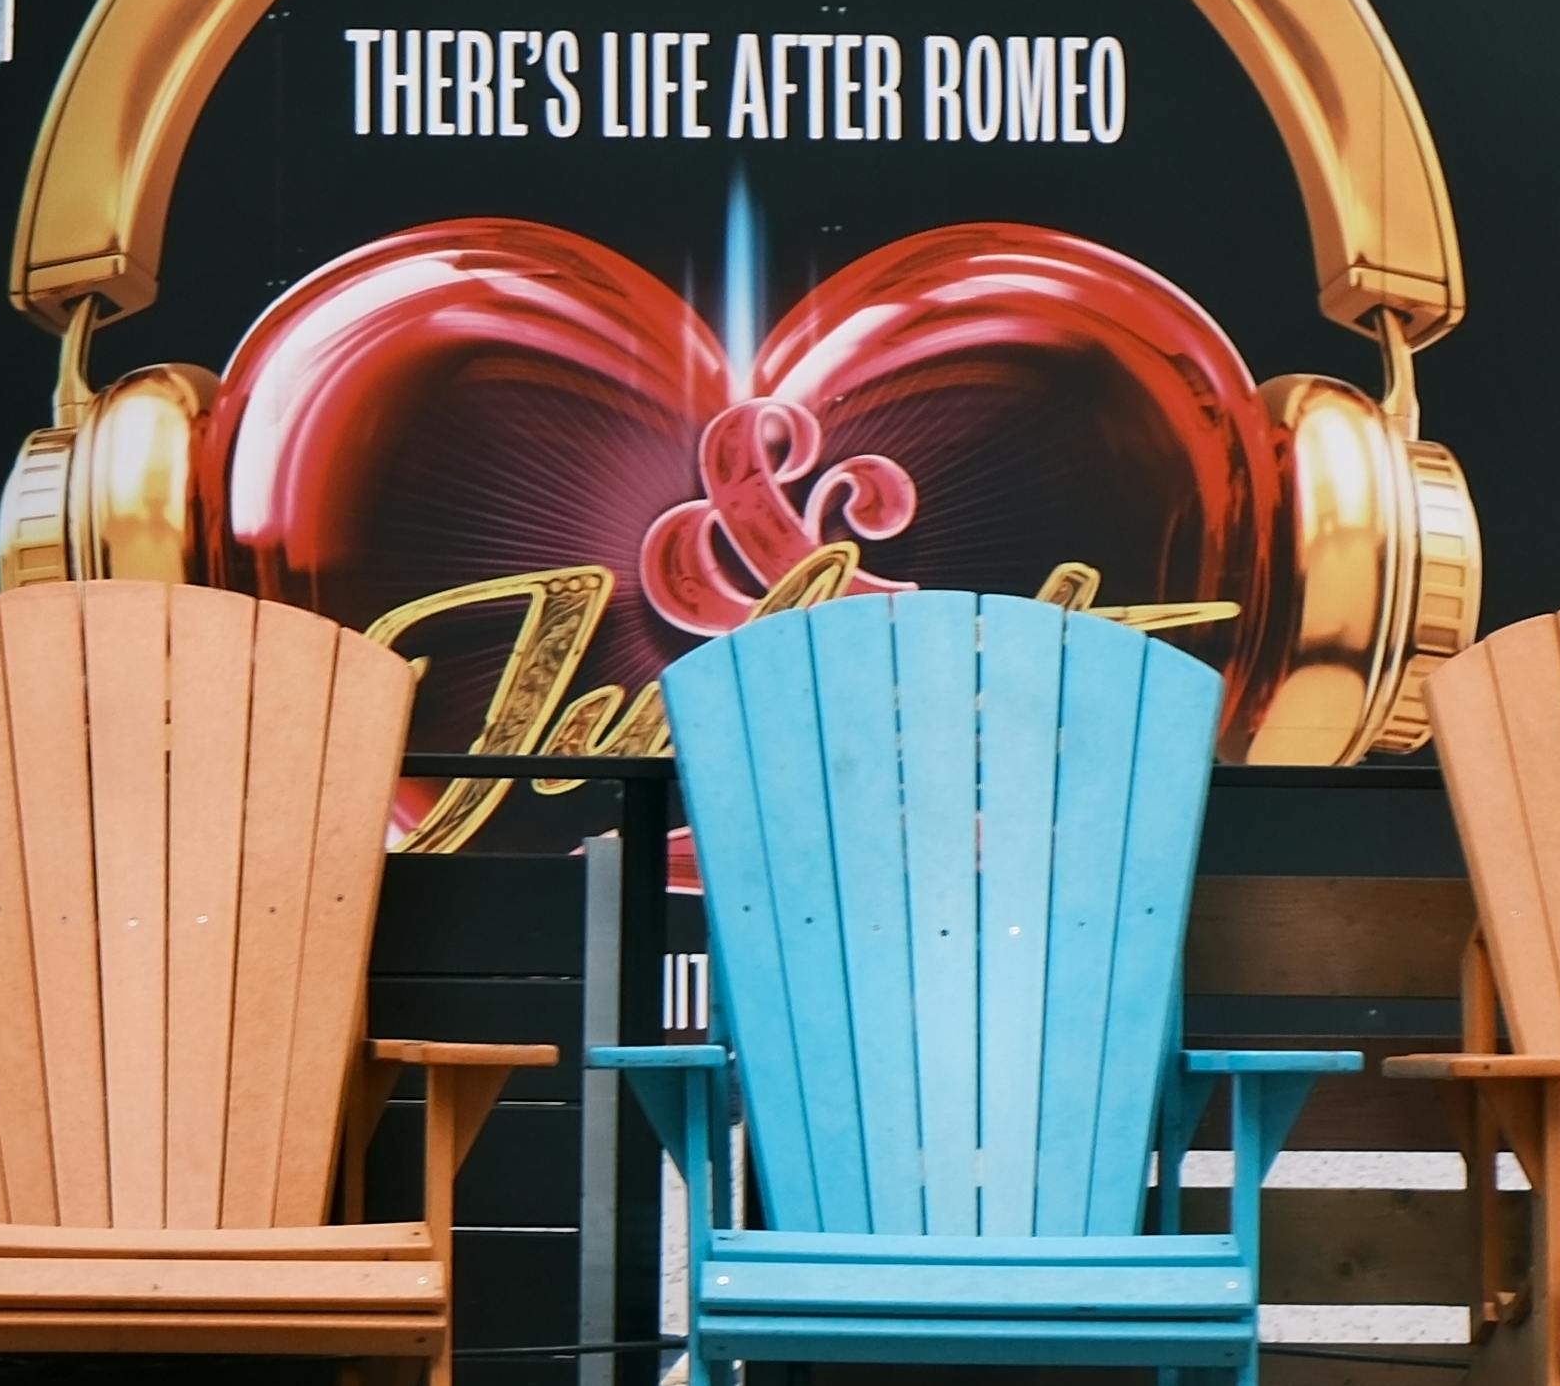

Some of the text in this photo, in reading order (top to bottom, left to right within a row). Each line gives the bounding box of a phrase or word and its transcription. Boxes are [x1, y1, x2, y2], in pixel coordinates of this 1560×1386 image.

[602, 31, 711, 139] LIFE
[727, 33, 902, 141] AFTER
[924, 34, 1126, 143] ROMEO
